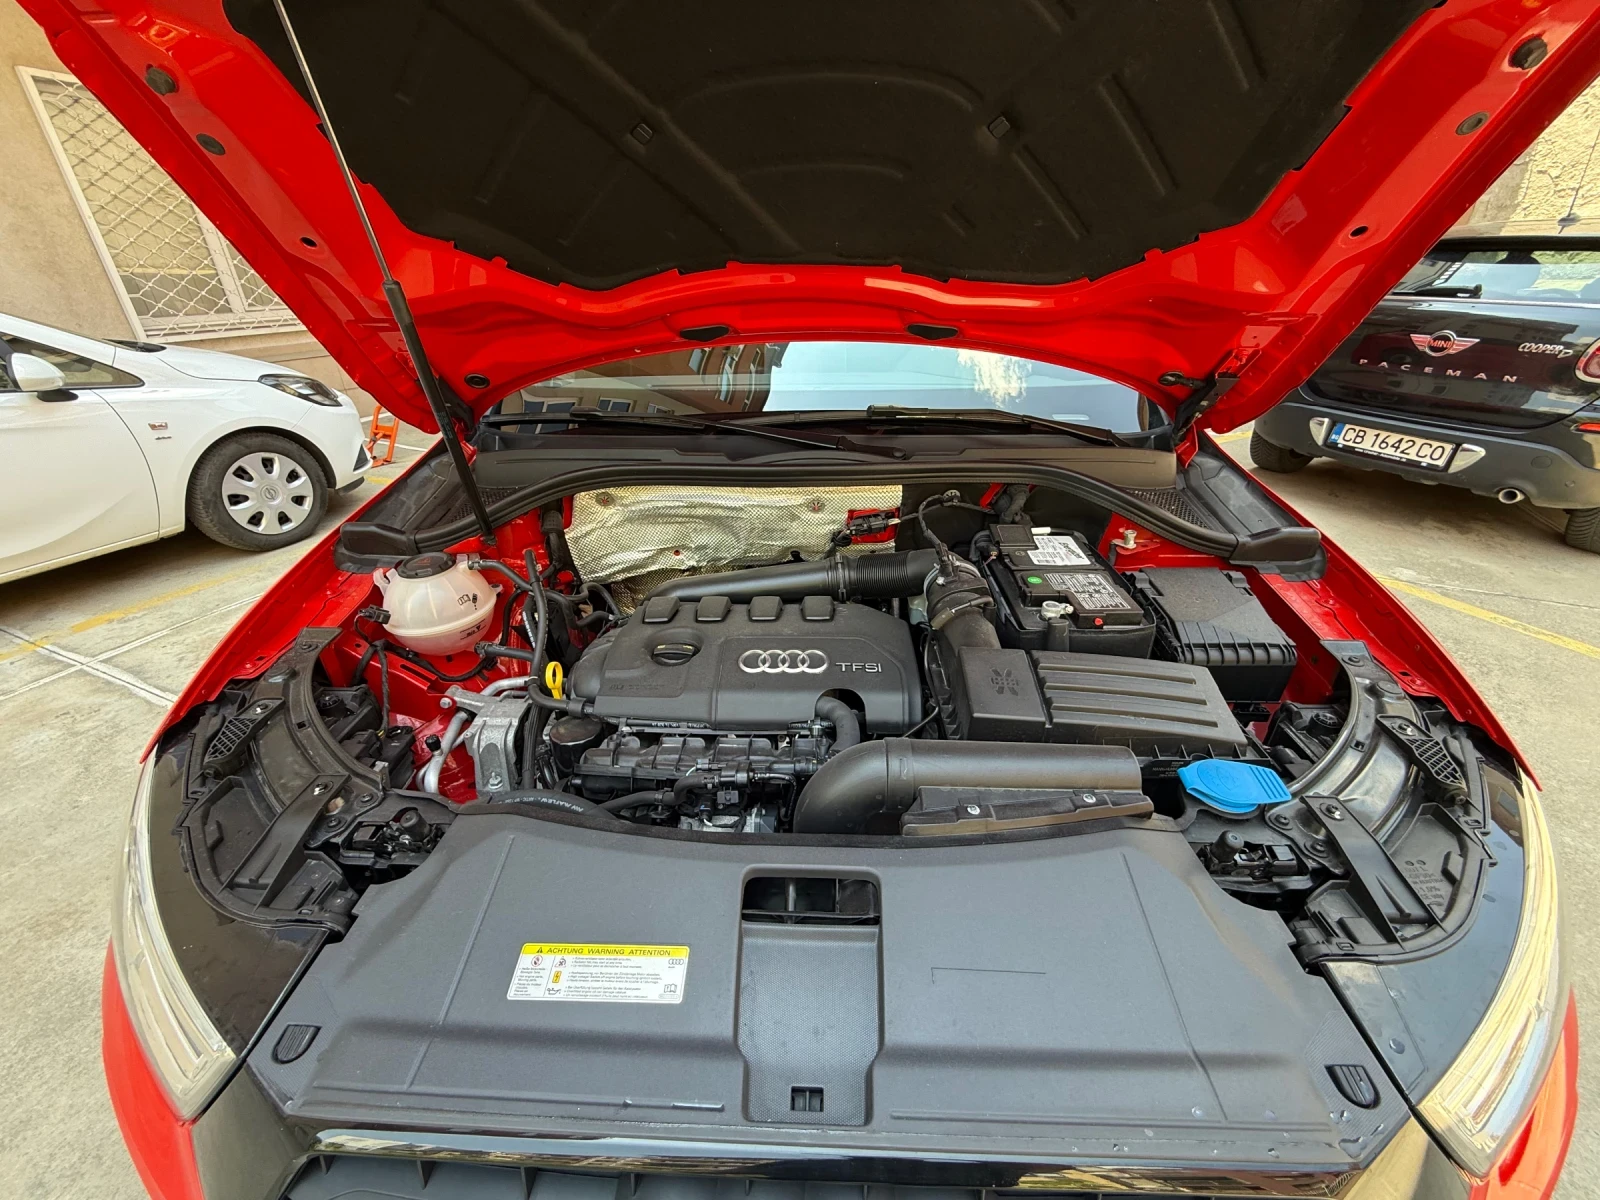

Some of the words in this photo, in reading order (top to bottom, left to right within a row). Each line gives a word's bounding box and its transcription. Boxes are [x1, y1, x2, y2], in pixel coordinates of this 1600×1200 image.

[1429, 340, 1452, 349] MINI
[1518, 342, 1563, 354] COOPER
[1557, 347, 1573, 359] D
[1359, 359, 1518, 383] PACEMAN
[1341, 427, 1367, 445] CB
[1371, 432, 1416, 456] 1642
[1415, 443, 1445, 461] CO
[836, 662, 882, 674] TFSI
[546, 947, 584, 955] ACHTUNG
[587, 948, 625, 956] WARNING
[628, 949, 671, 957] ATTENTION
